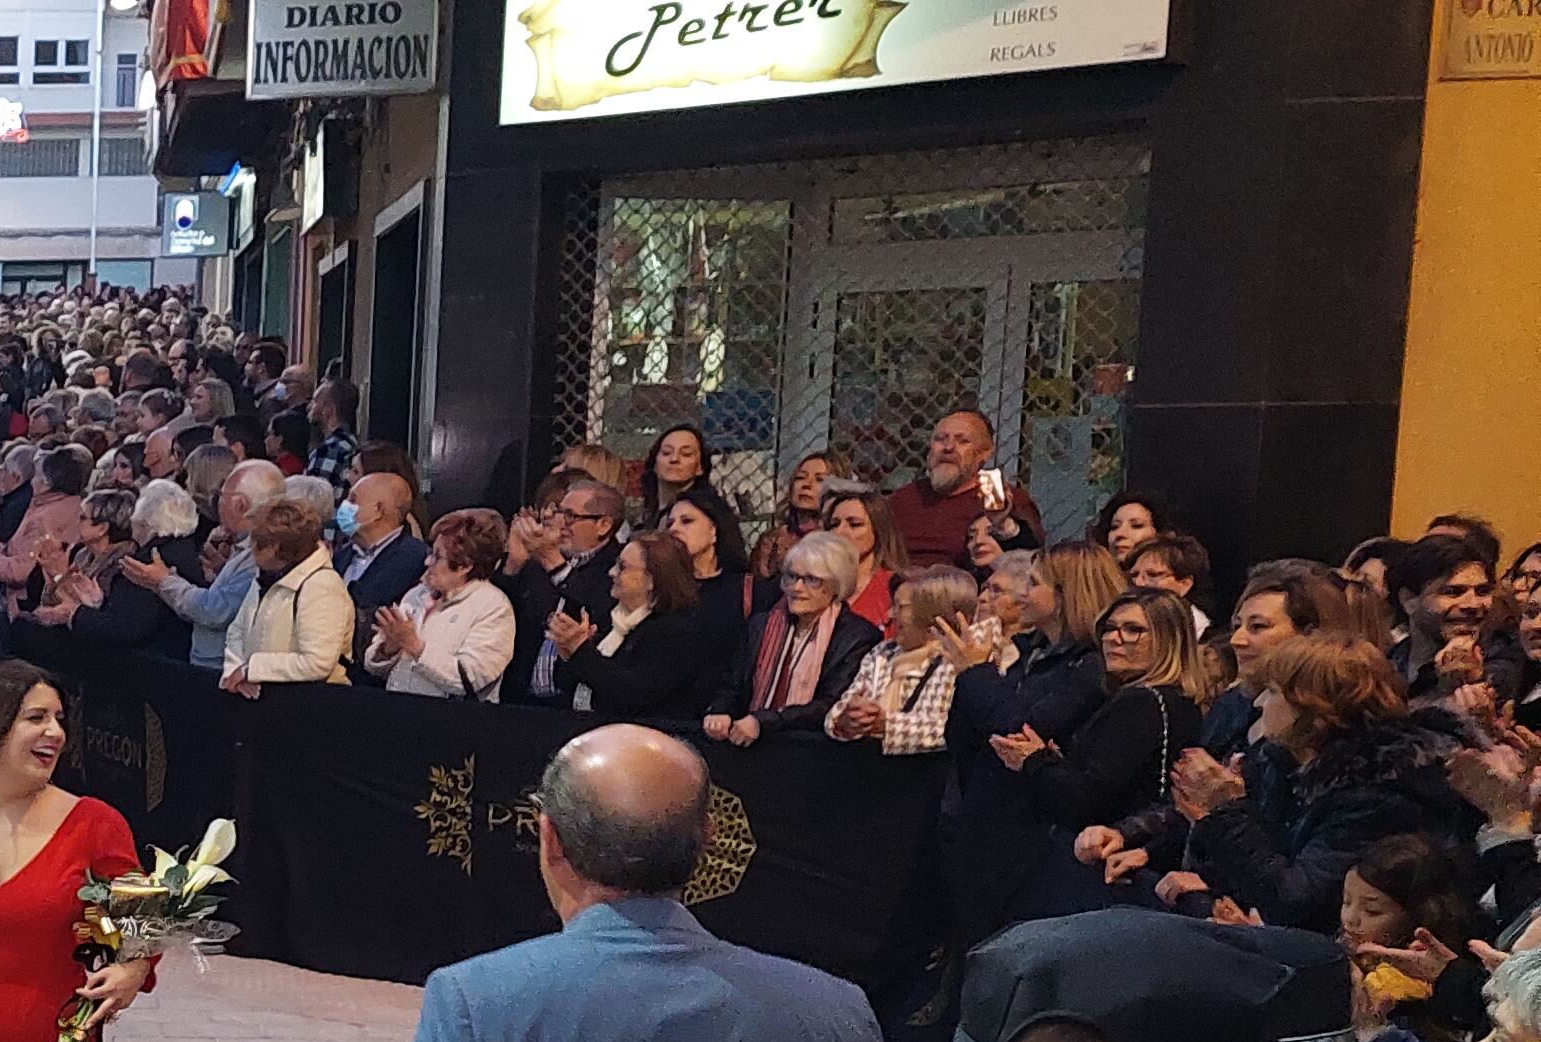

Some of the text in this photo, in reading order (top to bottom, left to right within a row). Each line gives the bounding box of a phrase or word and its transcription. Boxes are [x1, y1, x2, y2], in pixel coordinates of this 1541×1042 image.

[285, 2, 403, 29] DIARIO
[992, 5, 1059, 27] LLIBRES
[254, 33, 430, 85] INFORMACION
[989, 42, 1058, 63] REGALS
